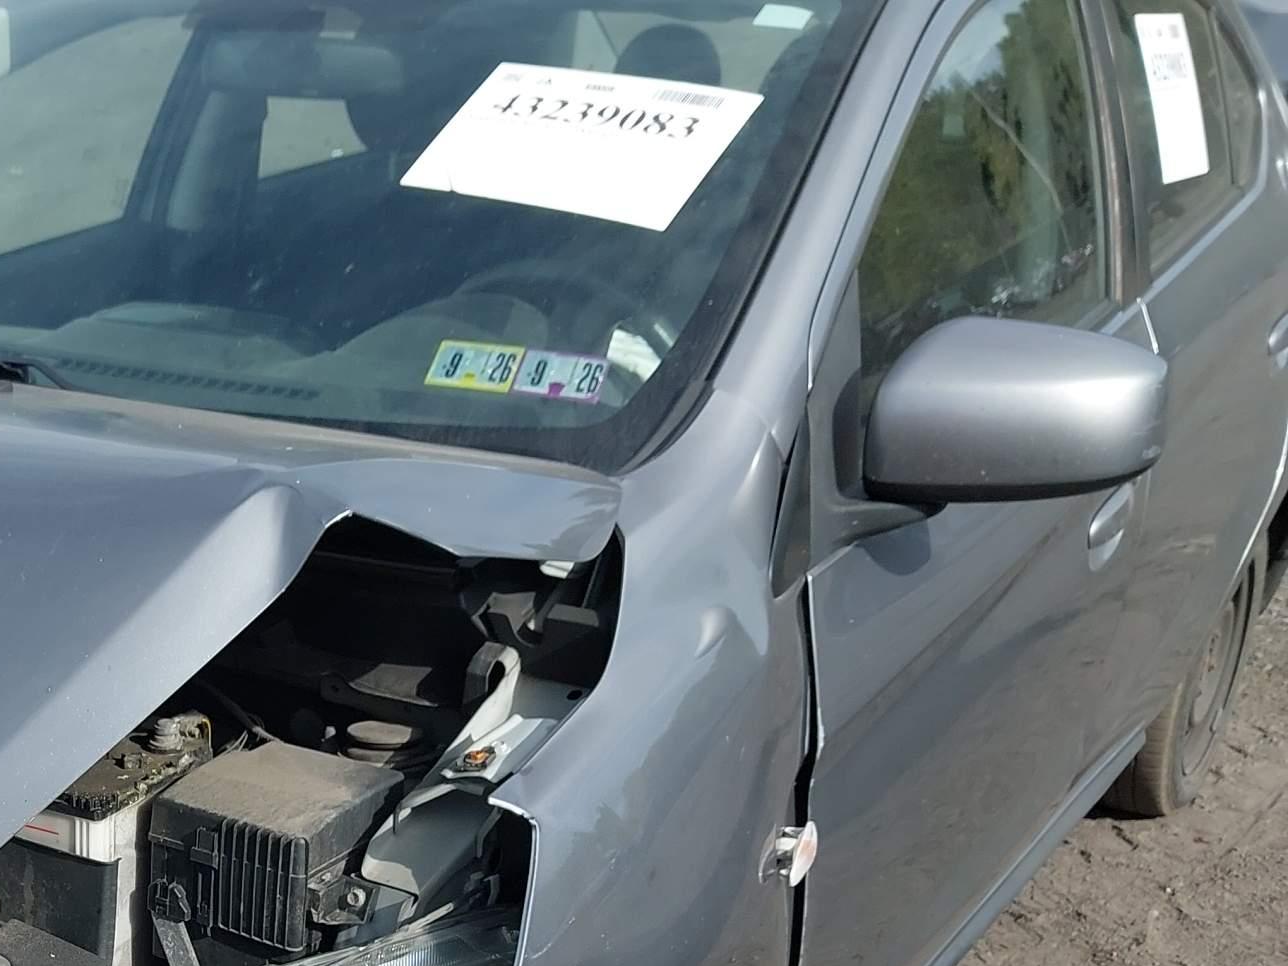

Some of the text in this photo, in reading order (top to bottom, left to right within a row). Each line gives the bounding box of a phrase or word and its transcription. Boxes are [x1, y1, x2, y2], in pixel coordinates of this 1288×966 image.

[493, 93, 701, 138] 43239083
[444, 352, 517, 384] 9 26
[530, 360, 604, 394] 9 26
